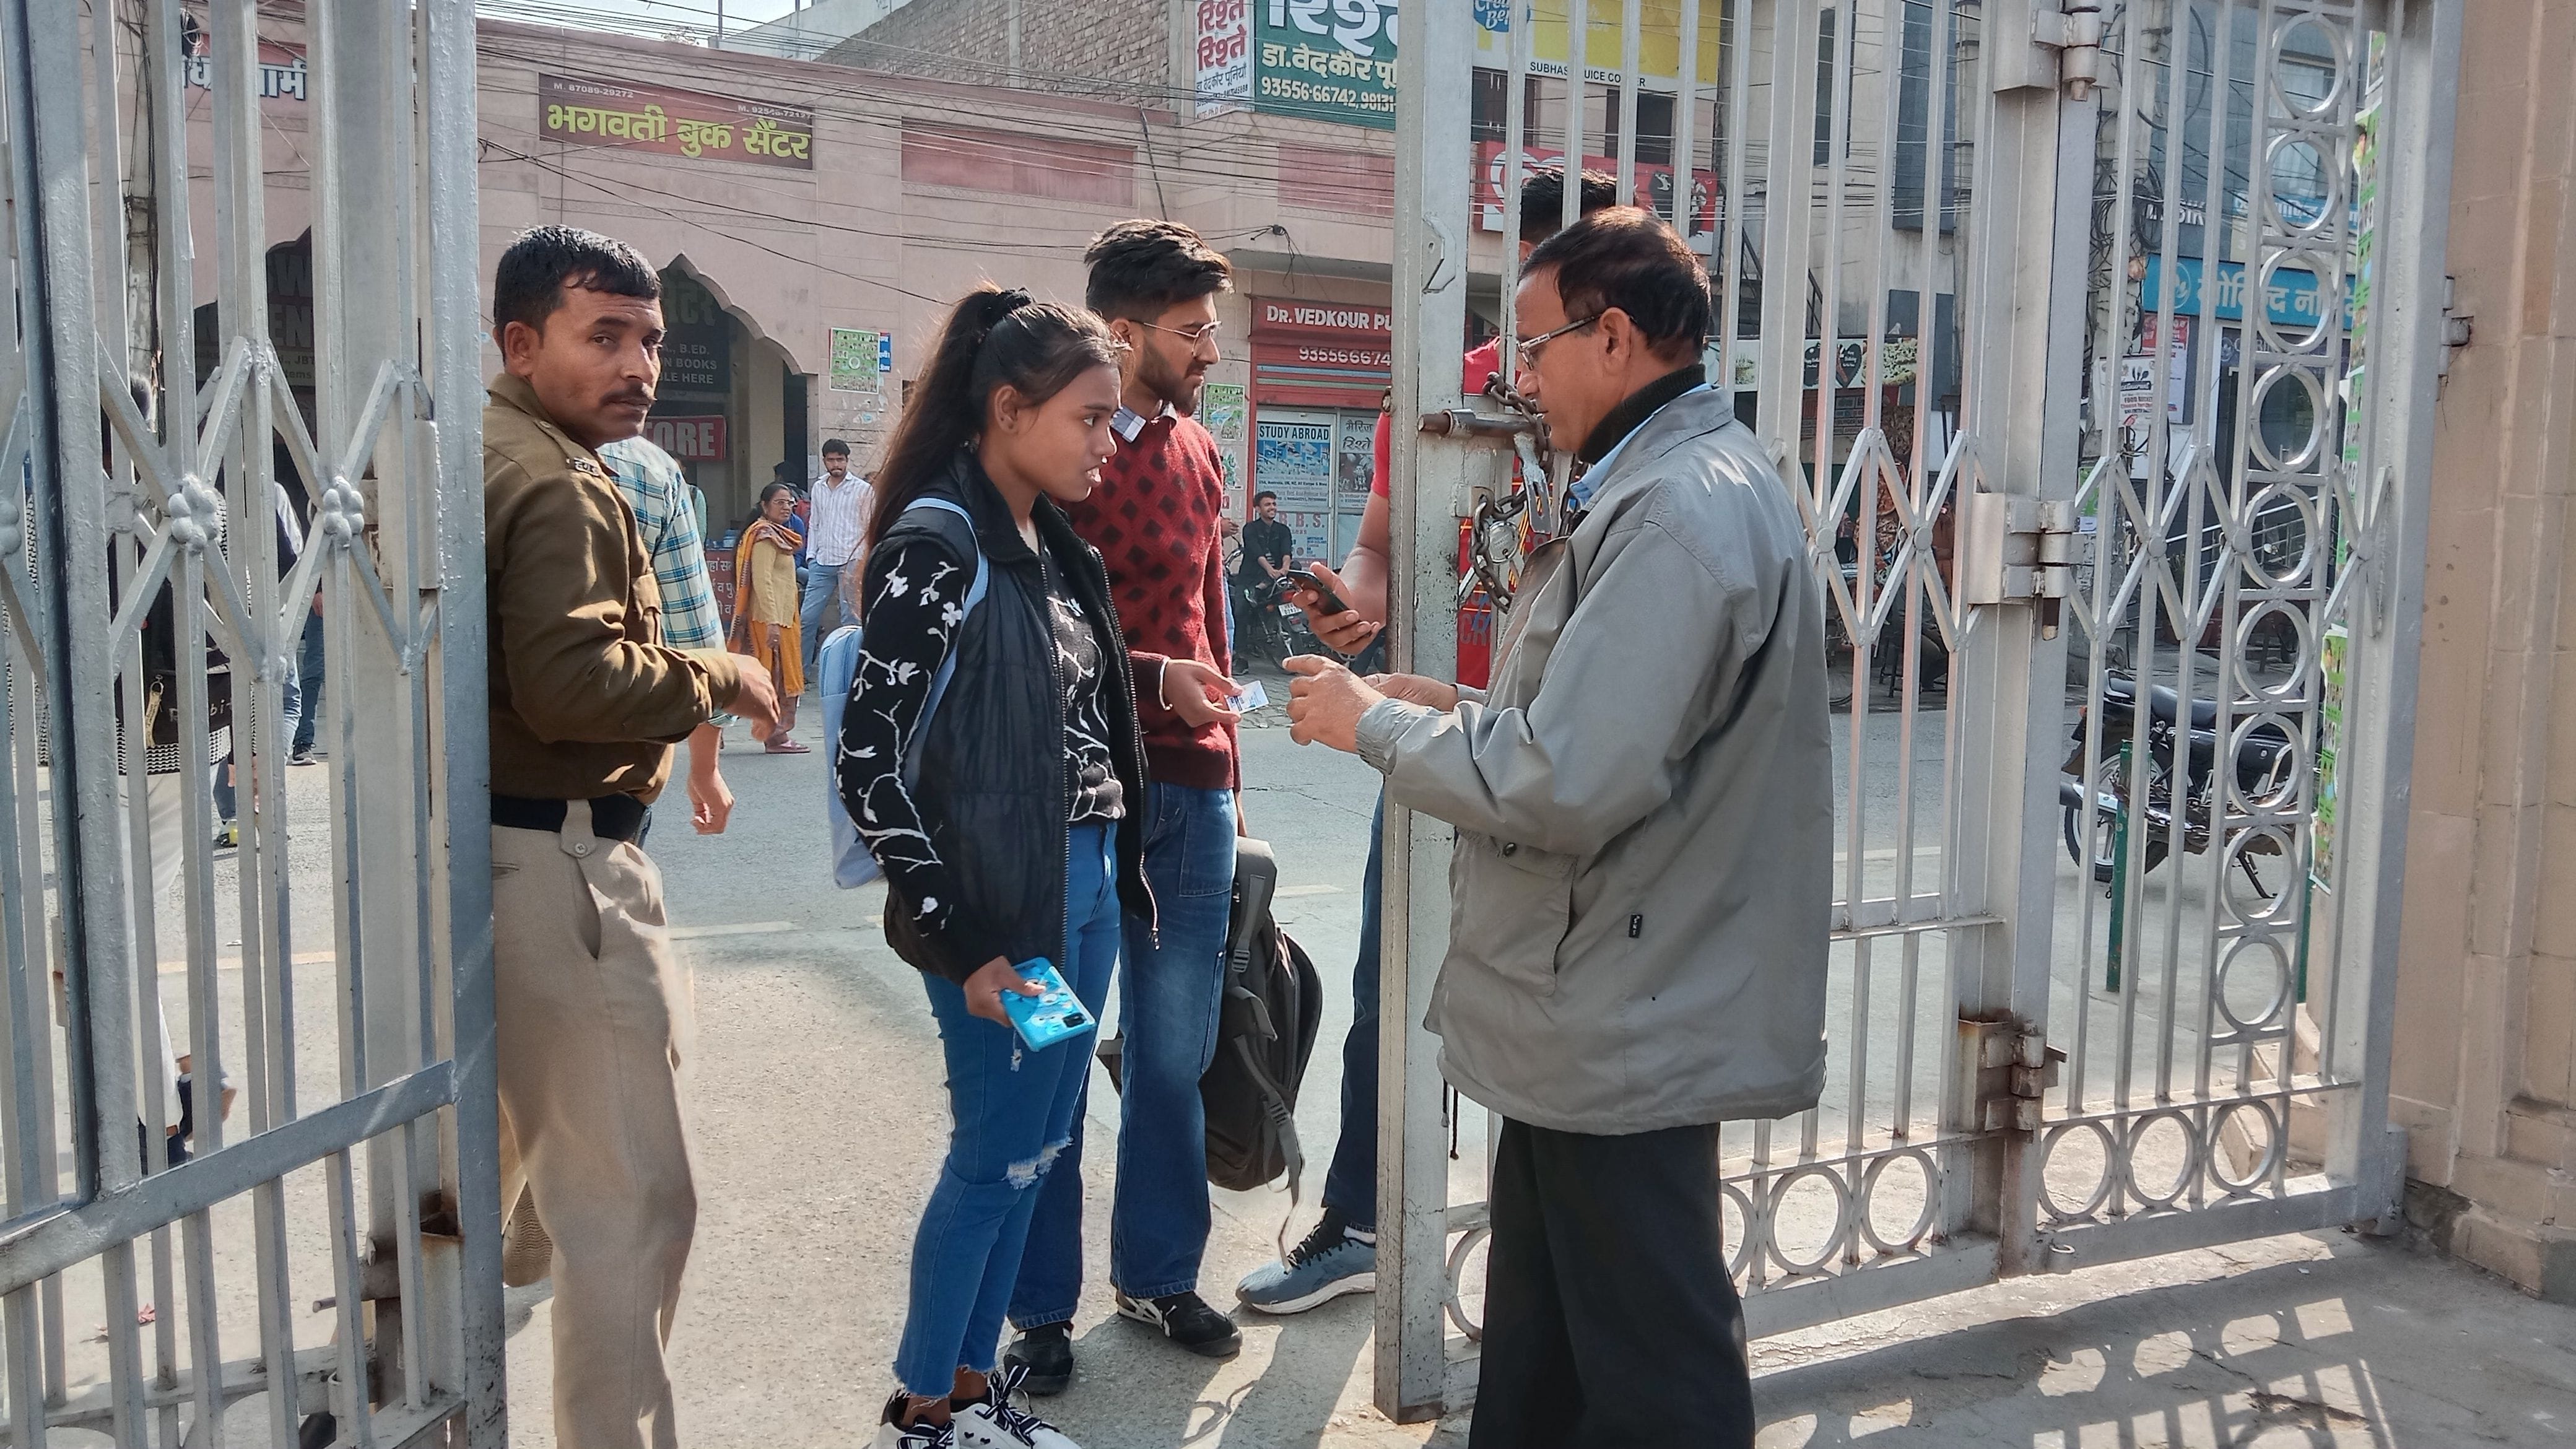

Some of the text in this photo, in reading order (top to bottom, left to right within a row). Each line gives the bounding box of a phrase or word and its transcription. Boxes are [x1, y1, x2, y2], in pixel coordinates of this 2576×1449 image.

[1197, 24, 1247, 71] रिश्ते
[1530, 62, 1568, 76] SUBHAS
[1584, 69, 1605, 80] UICE
[568, 84, 634, 98] 87089-29272
[547, 103, 669, 143] भगवती
[675, 118, 735, 159] बुक
[1294, 308, 1369, 329] VEDKOUR
[679, 342, 710, 355] B.ED.
[676, 357, 718, 370] BOOKS
[682, 374, 714, 385] HERE
[1260, 425, 1329, 440] STUDY ABROAD
